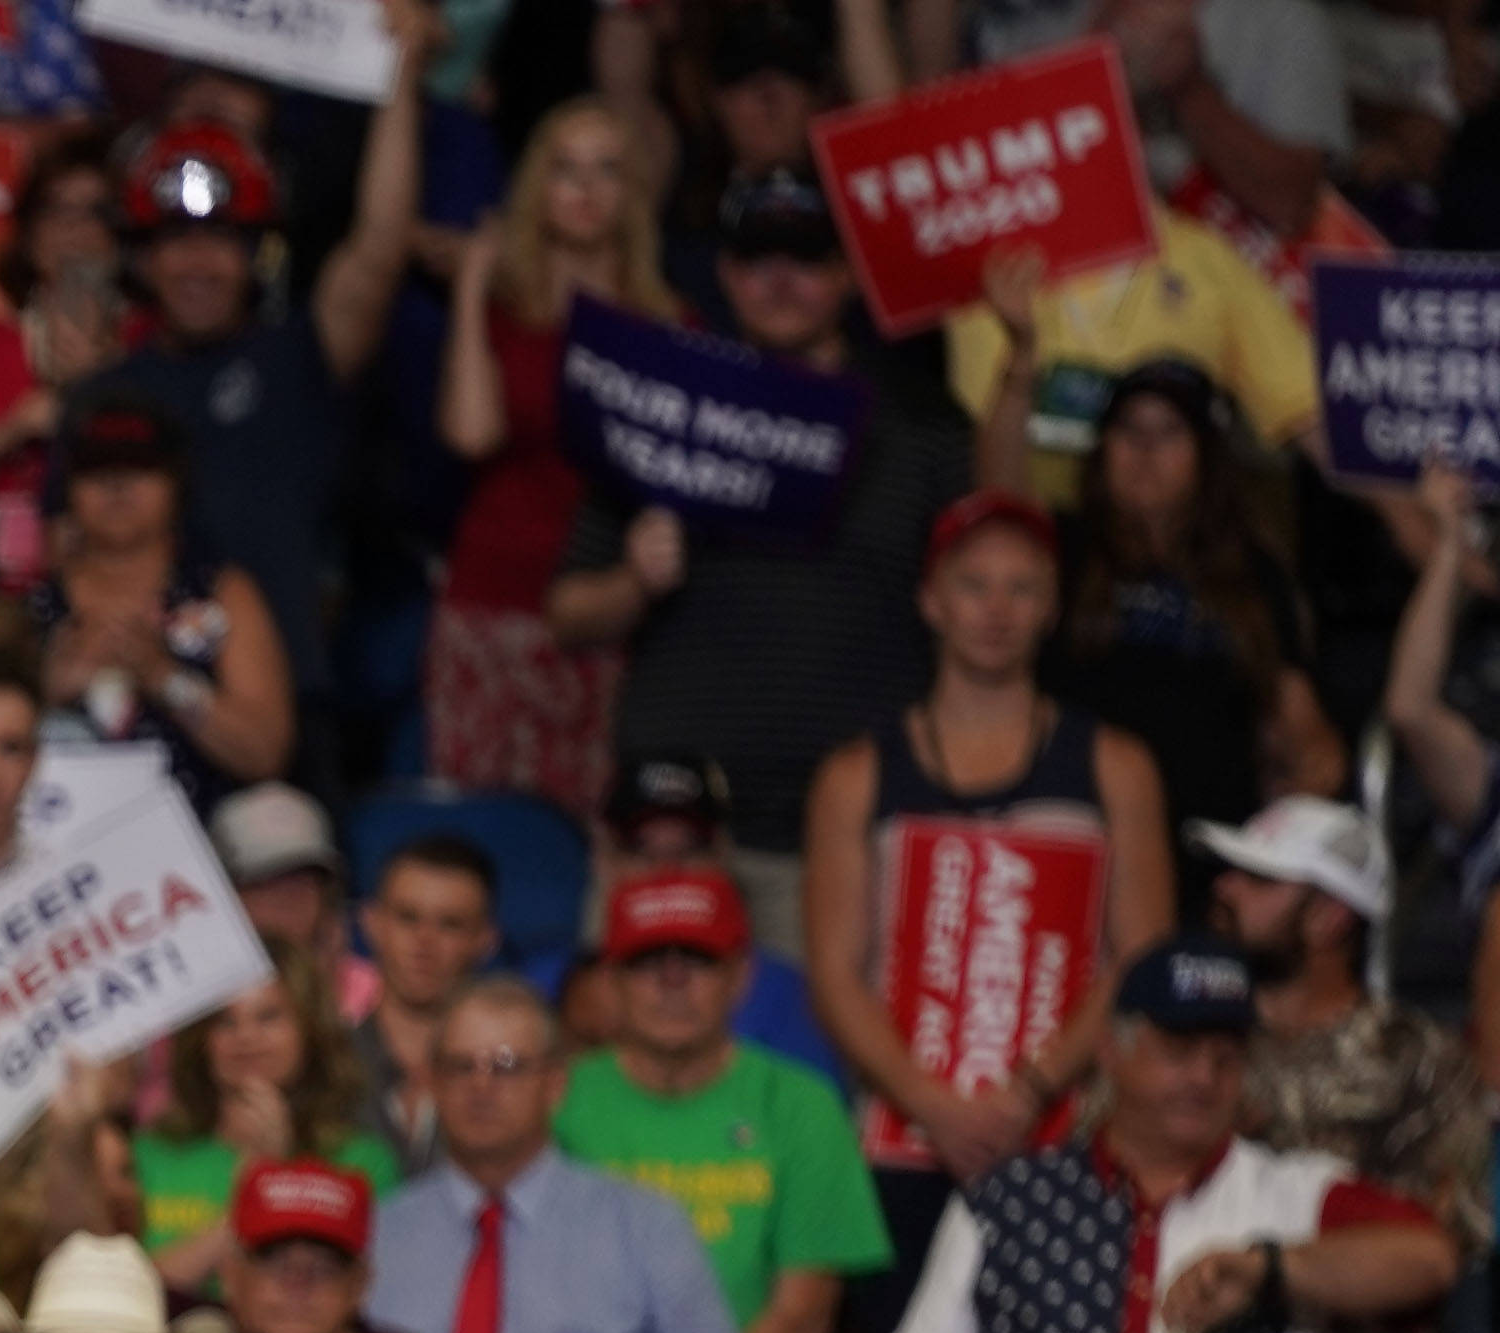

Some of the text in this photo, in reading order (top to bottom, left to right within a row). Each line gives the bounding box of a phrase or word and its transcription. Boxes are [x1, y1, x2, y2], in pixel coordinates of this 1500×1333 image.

[844, 103, 1108, 221] TRUMP
[564, 342, 694, 442] FOUR
[1361, 408, 1500, 464] GREA
[952, 837, 1037, 1102] AMERIC
